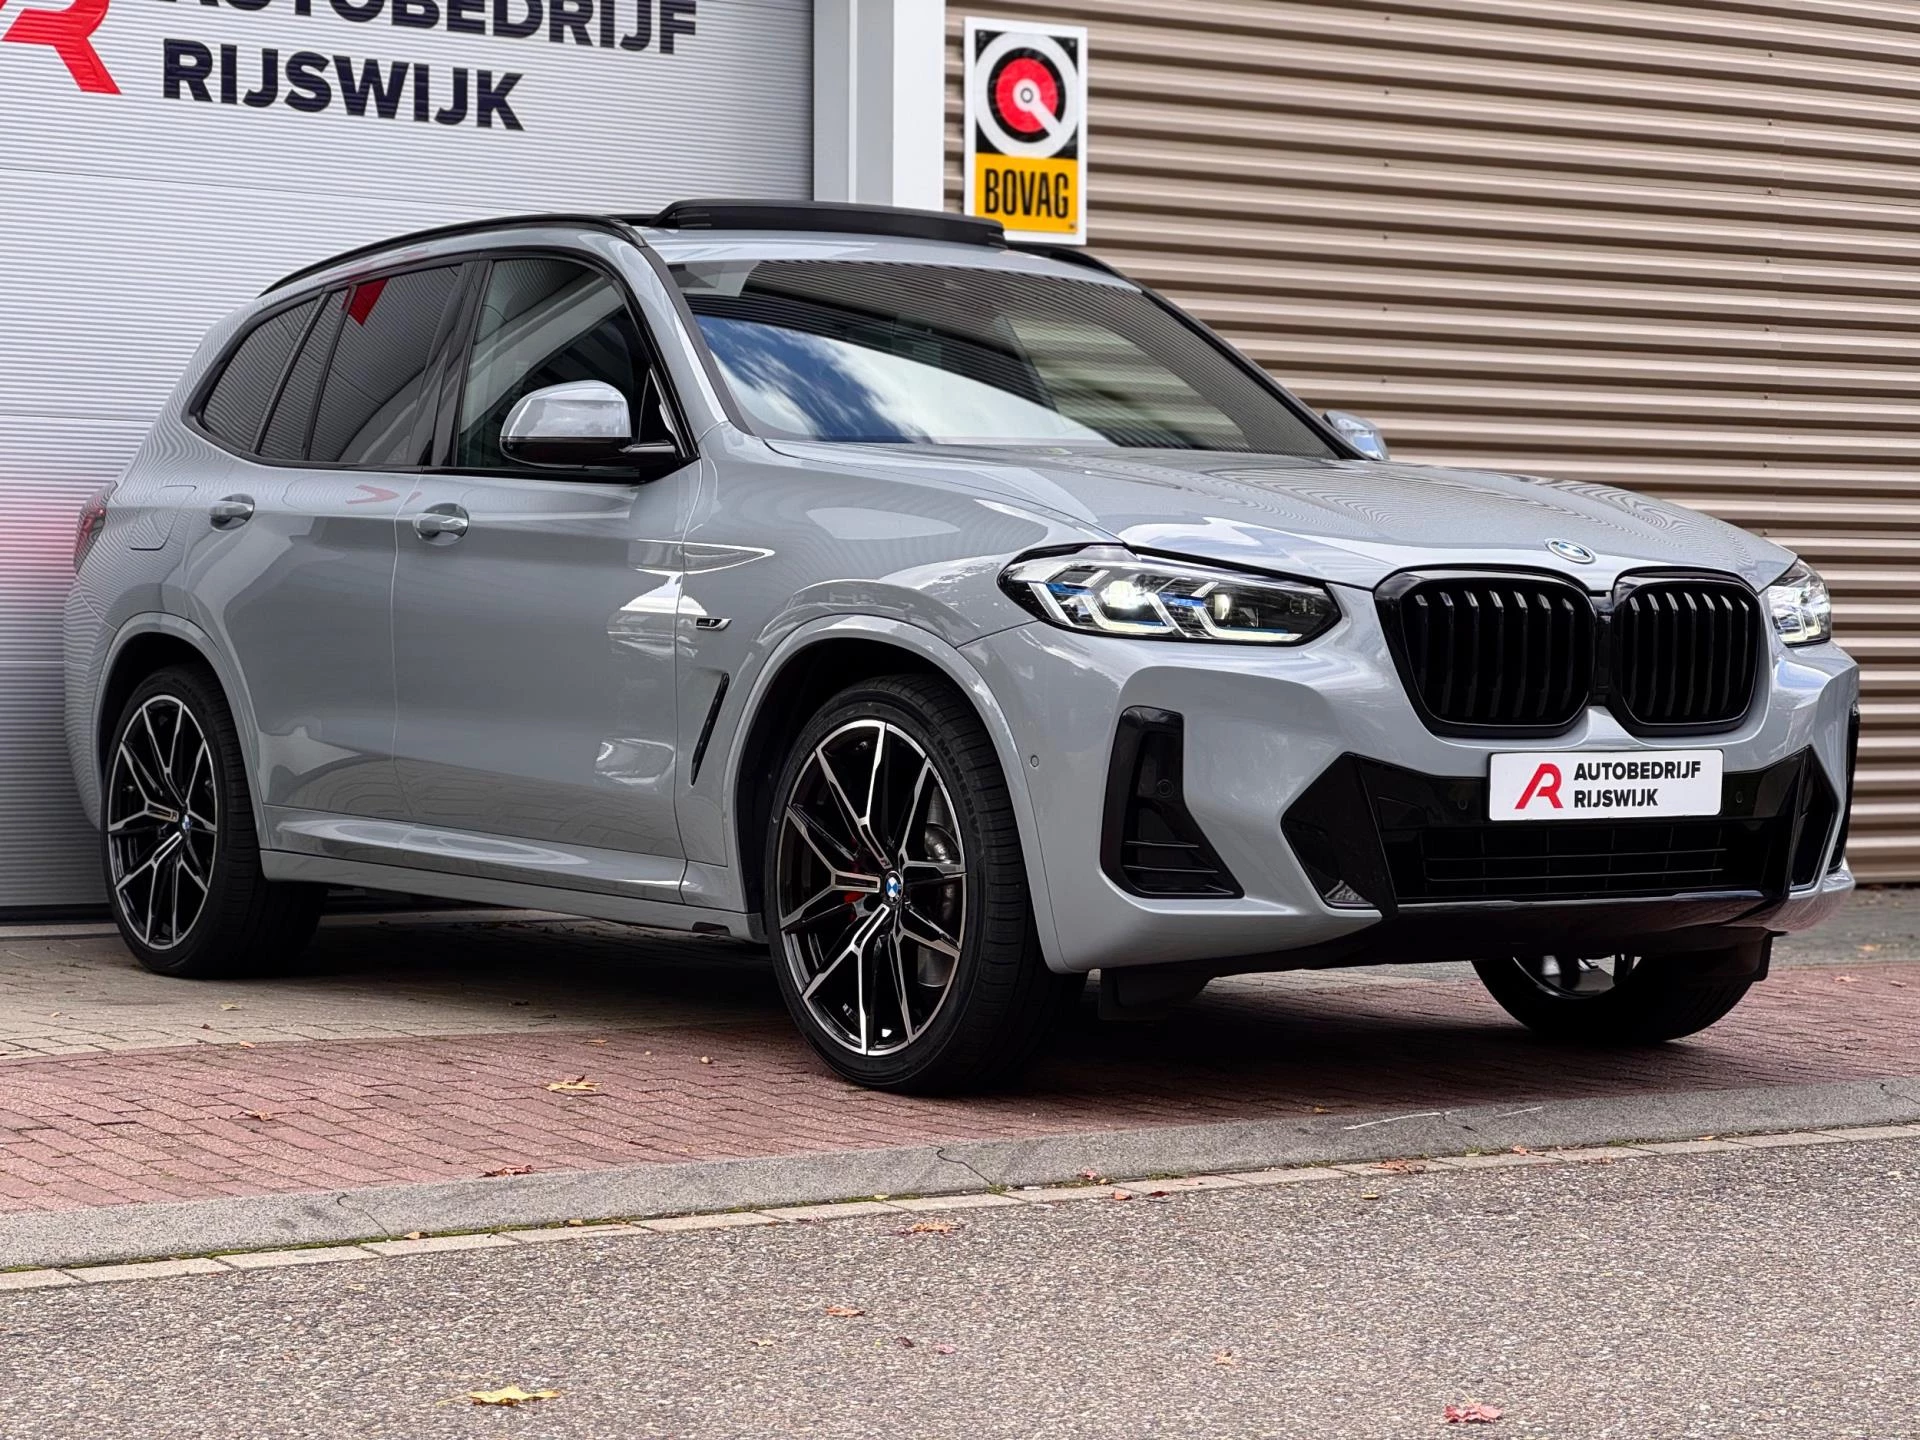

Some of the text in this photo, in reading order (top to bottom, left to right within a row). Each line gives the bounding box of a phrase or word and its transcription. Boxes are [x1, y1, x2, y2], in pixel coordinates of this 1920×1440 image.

[160, 0, 697, 54] EDRIJF
[163, 38, 525, 131] RIJSWIJK
[985, 168, 1069, 218] BOVAG
[1574, 761, 1701, 780] AUTOBEDRIJF
[1574, 789, 1658, 807] RIJSWIJK
